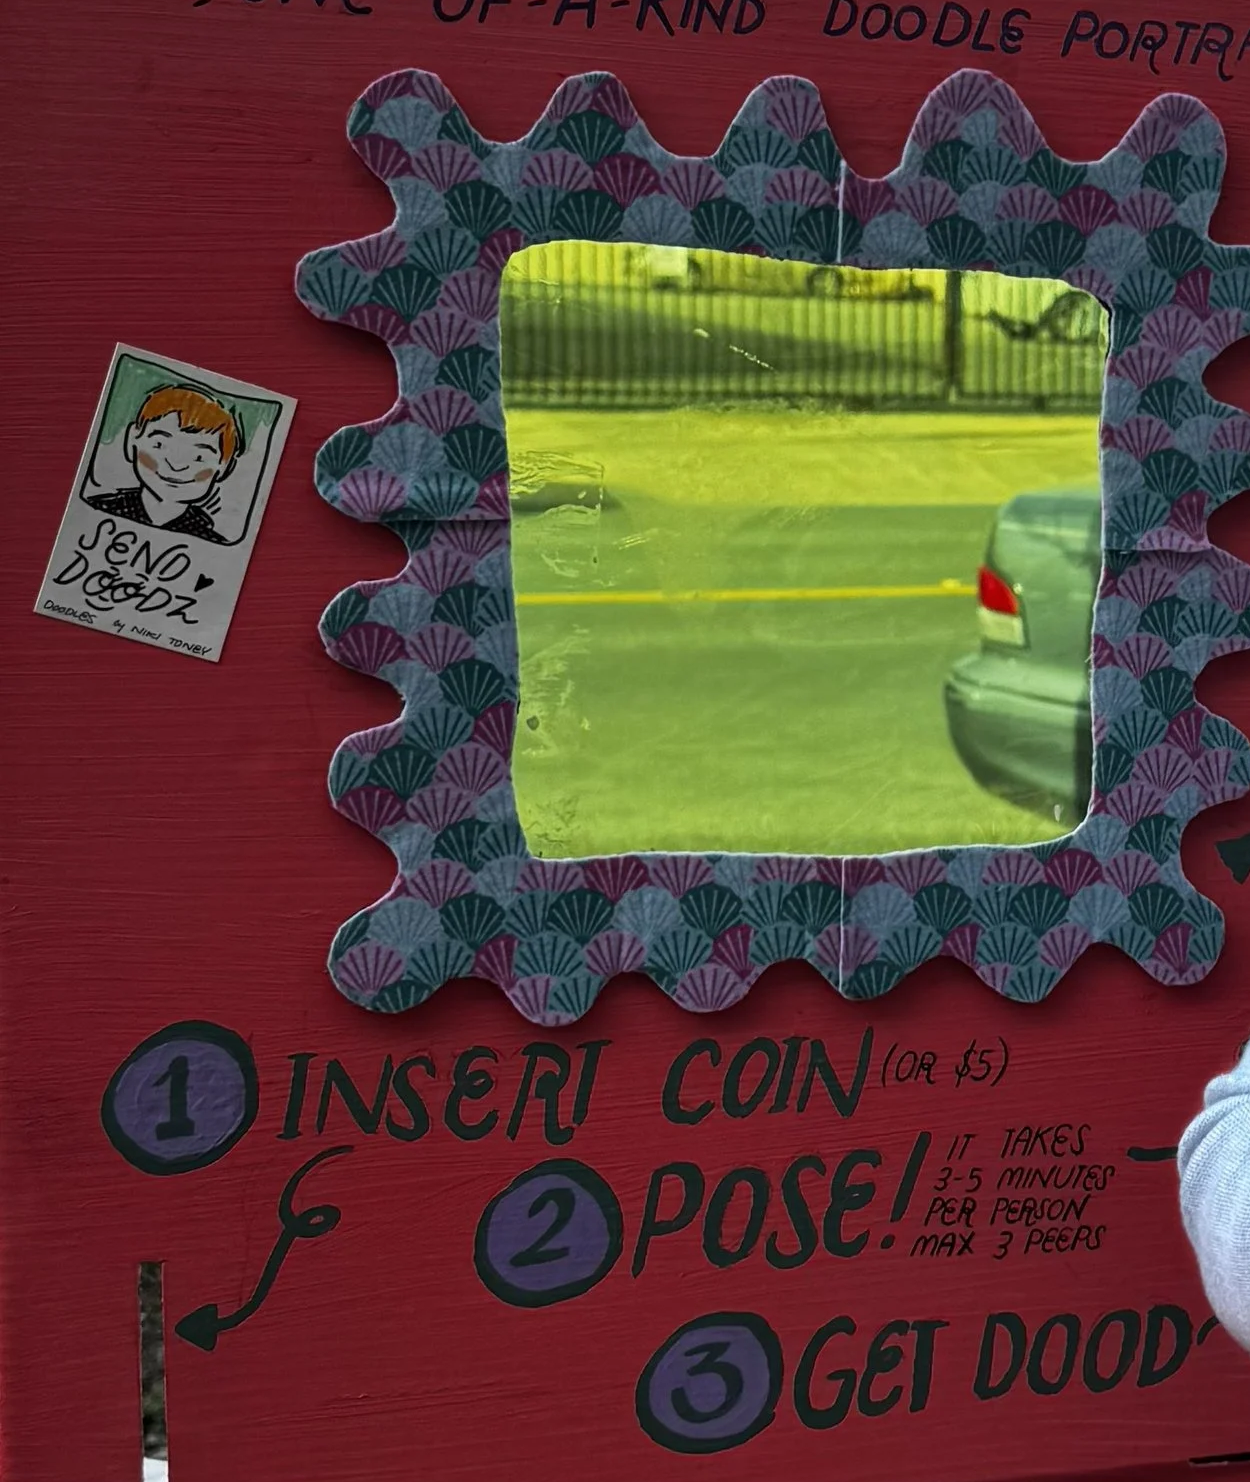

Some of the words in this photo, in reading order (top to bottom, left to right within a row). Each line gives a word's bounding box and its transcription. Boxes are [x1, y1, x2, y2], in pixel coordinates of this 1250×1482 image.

[78, 518, 191, 582] SEND
[131, 625, 162, 641] NIKI
[169, 636, 213, 657] TONEY
[153, 1056, 195, 1141] 1
[276, 1040, 611, 1145] INSERT
[661, 1026, 874, 1125] COIN
[880, 1042, 935, 1086] (OR
[954, 1036, 1009, 1087] $5)
[948, 1133, 975, 1161] IT
[1002, 1124, 1091, 1159] TAKES
[934, 1168, 982, 1191] 3-5
[997, 1165, 1116, 1191] MINUTES
[509, 1187, 576, 1267] 2
[631, 1131, 931, 1279] POSE!
[924, 1197, 975, 1227] PER
[990, 1191, 1089, 1226] PERSON
[910, 1231, 975, 1257] MAX
[993, 1232, 1008, 1259] 3
[1024, 1225, 1107, 1255] PEEPS
[671, 1341, 733, 1423] 3
[794, 1314, 950, 1430] GET
[973, 1303, 1223, 1402] DOOD
